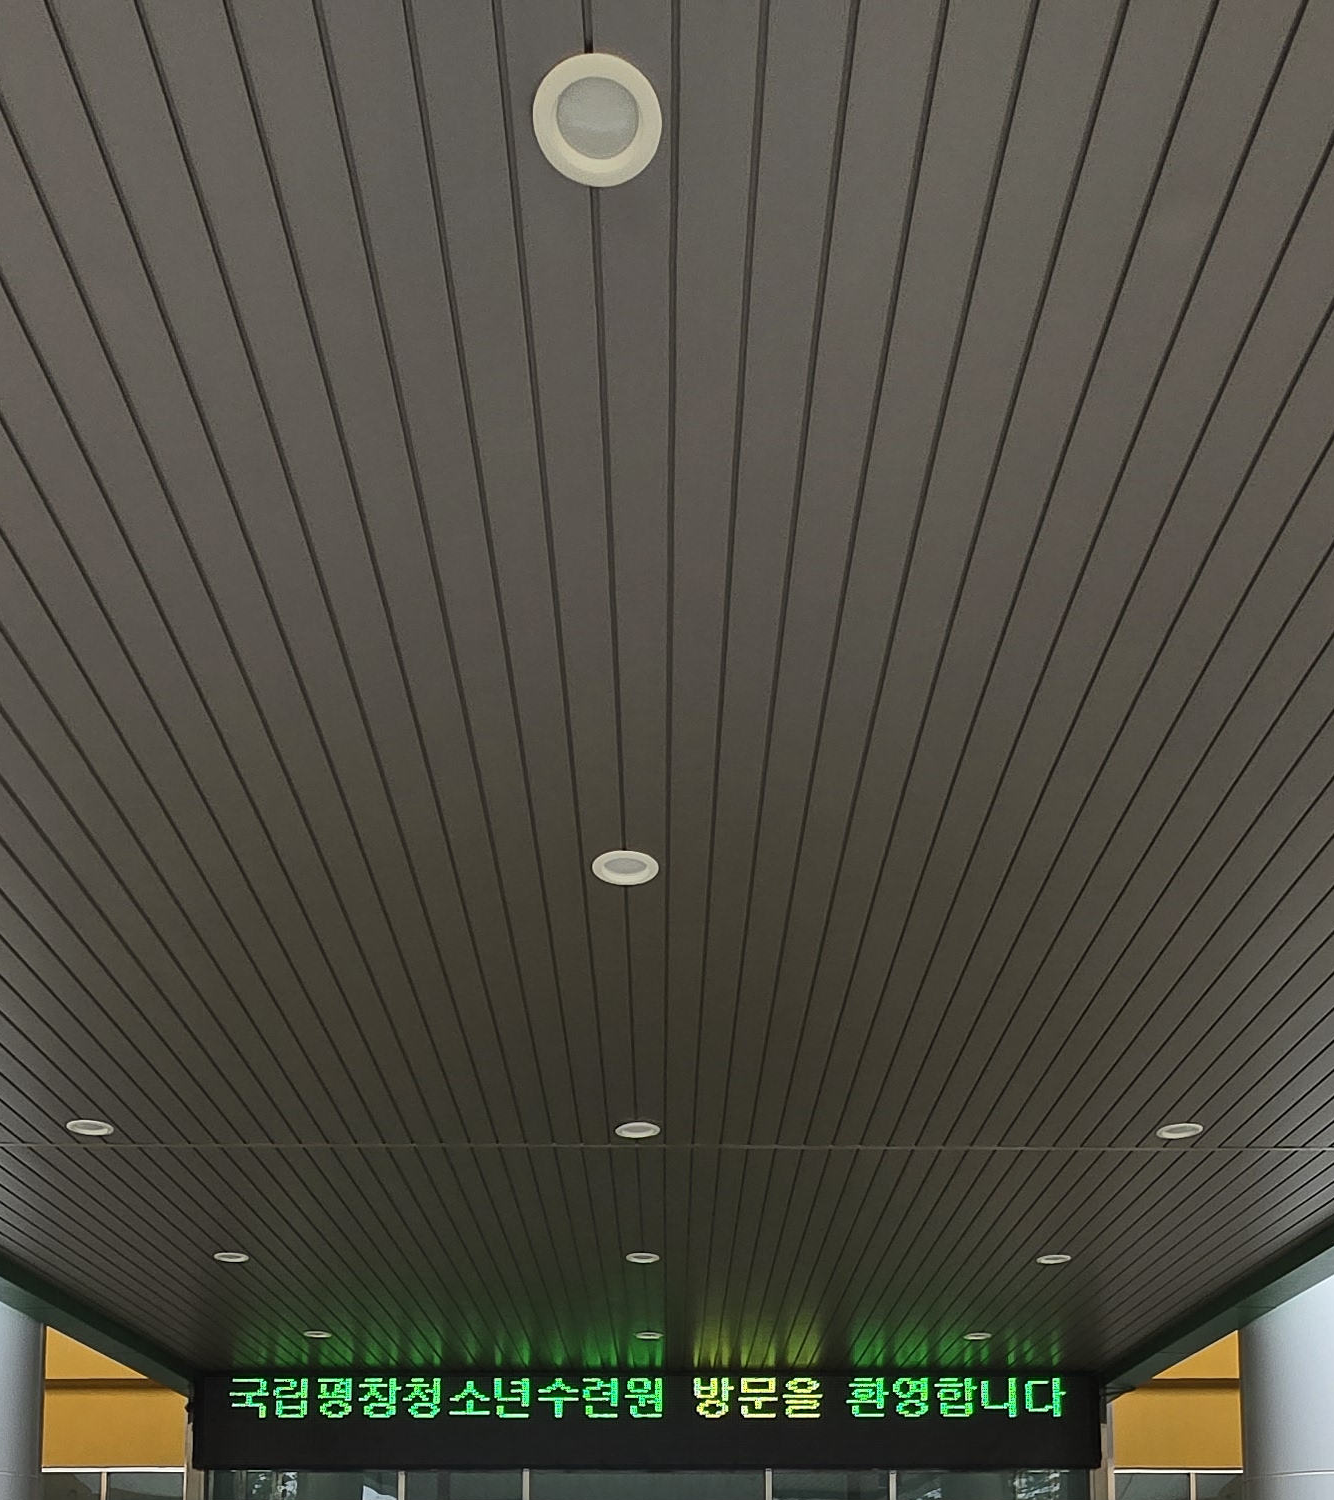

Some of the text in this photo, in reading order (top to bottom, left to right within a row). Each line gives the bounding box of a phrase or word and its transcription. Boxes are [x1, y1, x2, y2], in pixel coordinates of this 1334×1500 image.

[229, 1377, 1067, 1419] 국립평창청소년수련원 방문을 환영합니다
